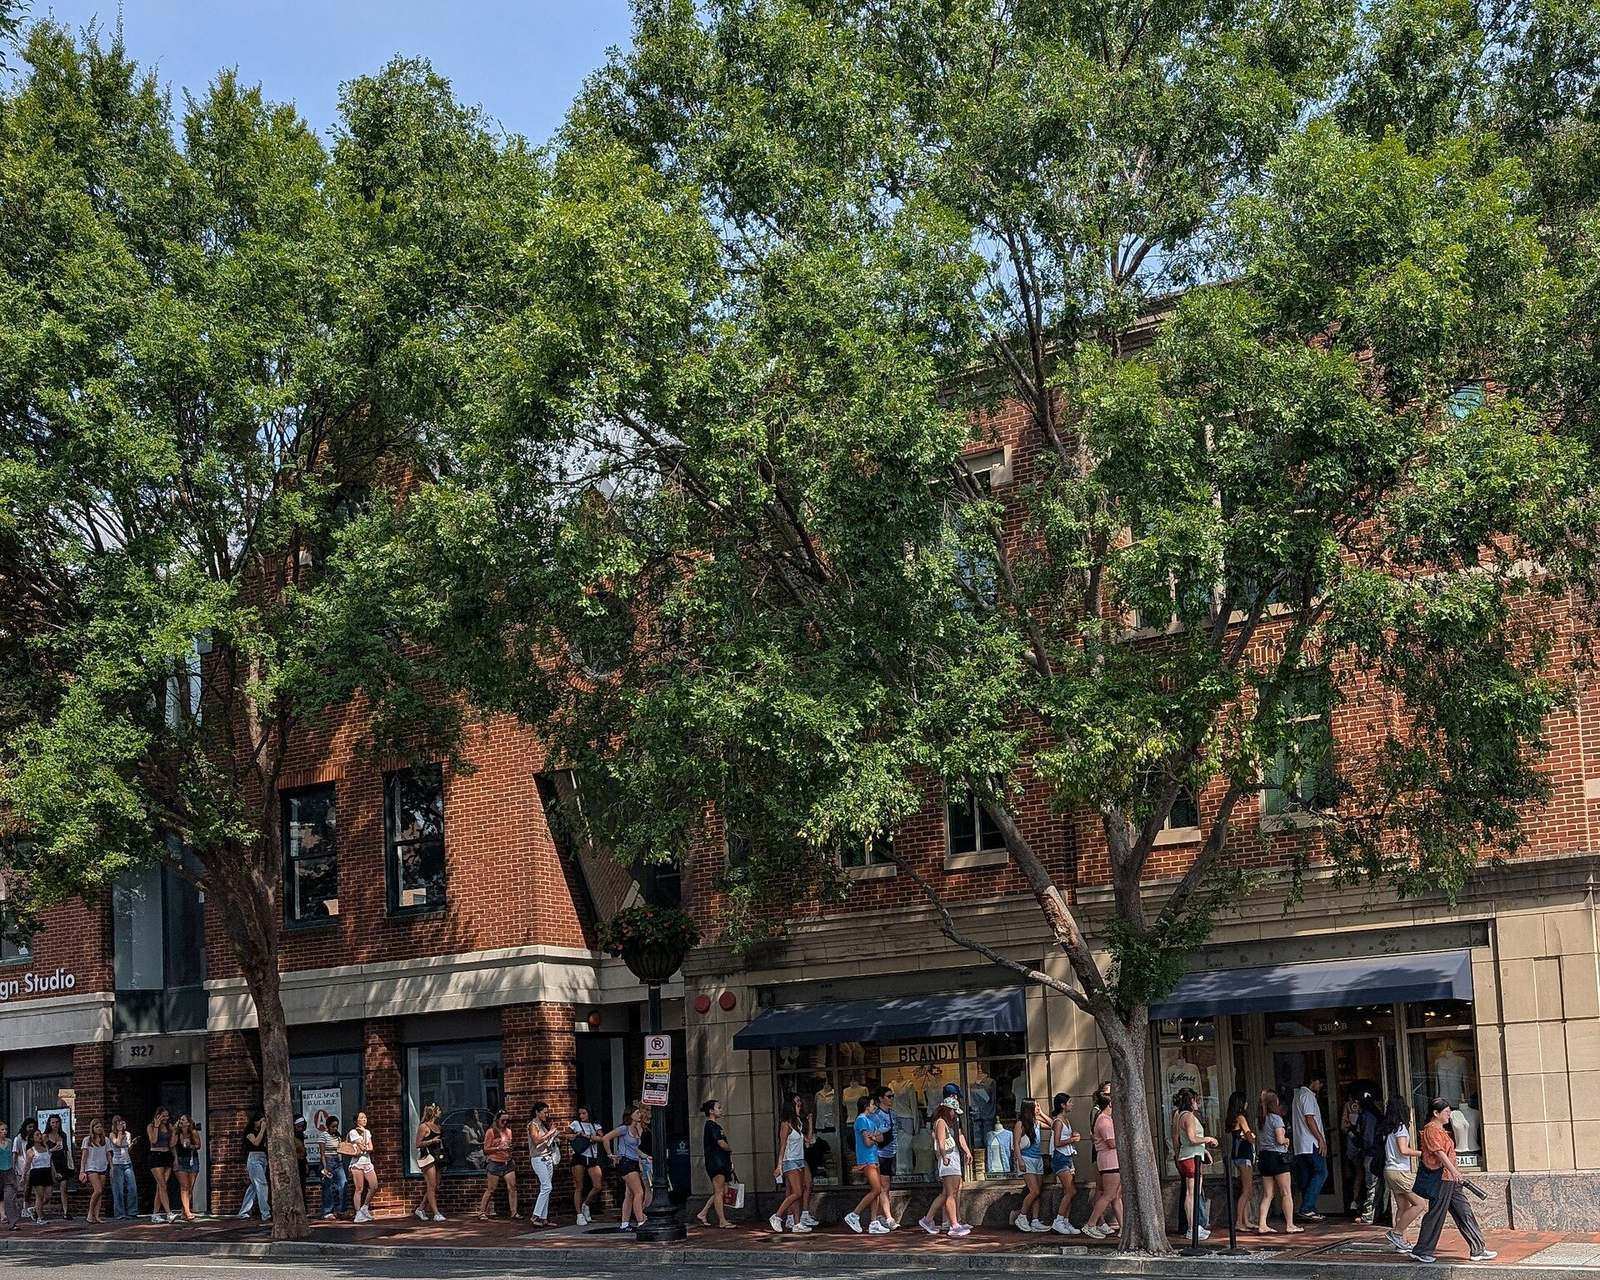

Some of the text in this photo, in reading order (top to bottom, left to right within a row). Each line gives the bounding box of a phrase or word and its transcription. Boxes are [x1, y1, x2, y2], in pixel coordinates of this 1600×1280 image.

[24, 968, 75, 993] Studio
[130, 1044, 154, 1056] 3327
[899, 1044, 957, 1062] BRANDY
